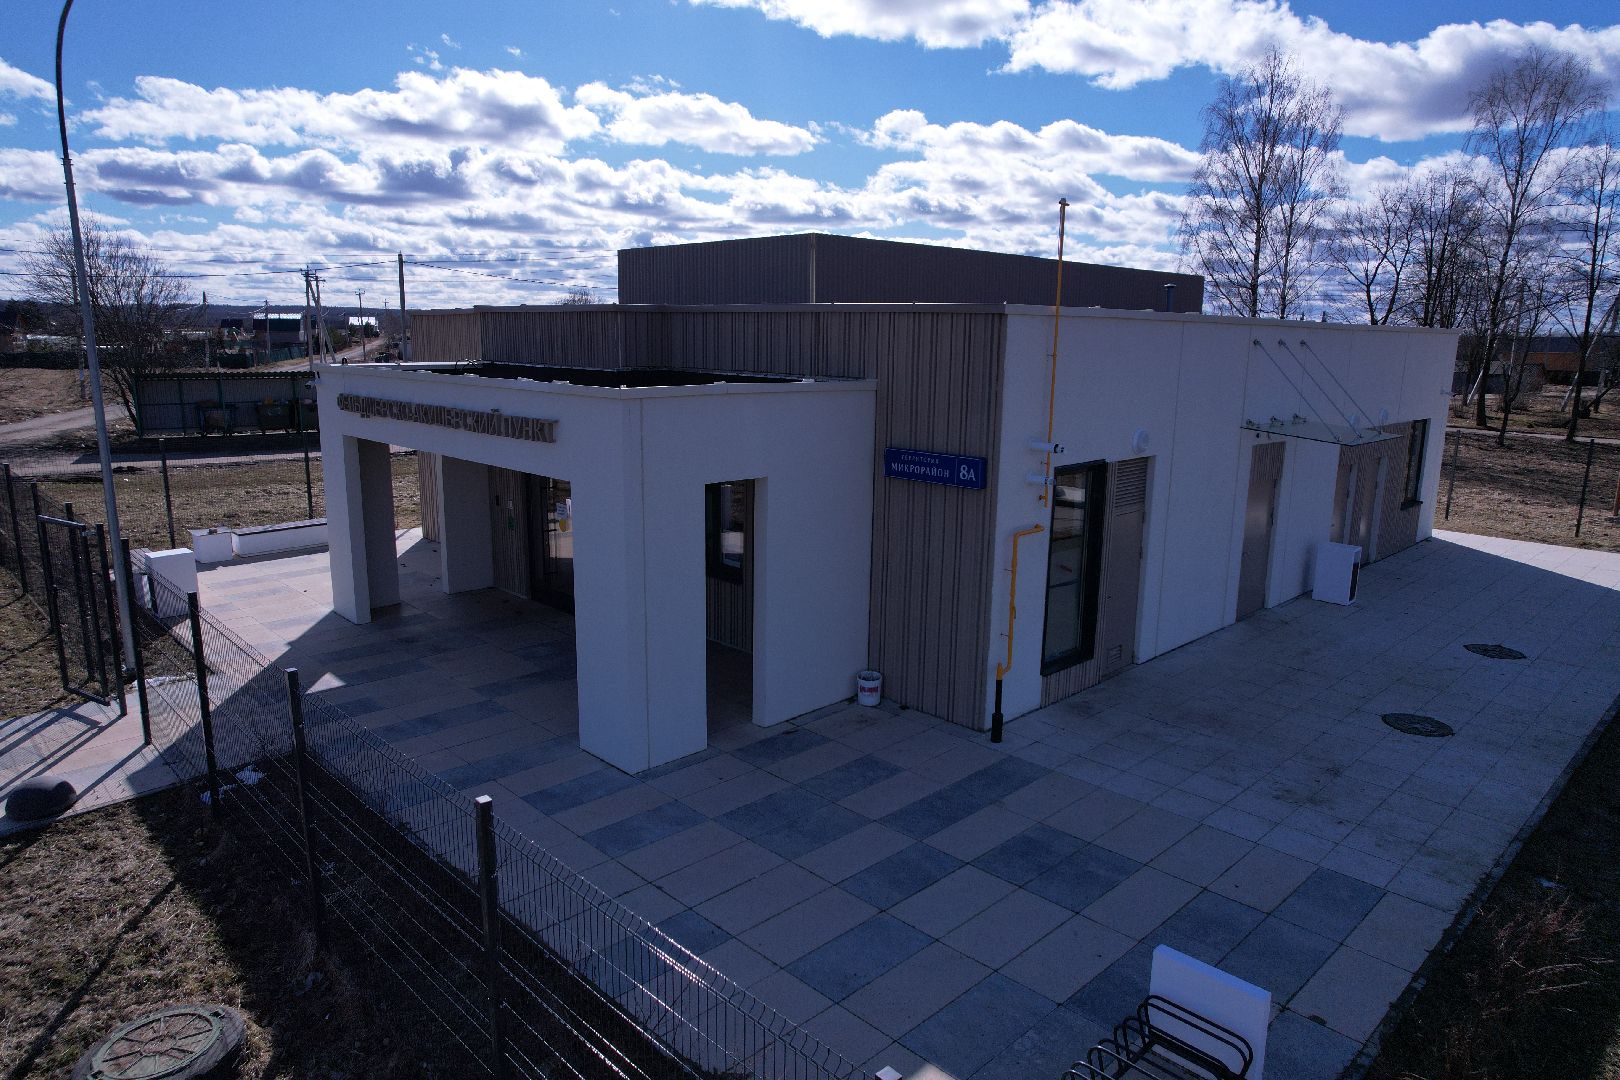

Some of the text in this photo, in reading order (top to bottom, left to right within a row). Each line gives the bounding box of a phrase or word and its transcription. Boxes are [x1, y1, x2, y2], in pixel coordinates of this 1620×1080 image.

[502, 416, 559, 443] ПУНКТ
[891, 462, 950, 478] МИКРОРАЙОН
[959, 465, 976, 481] 8А
